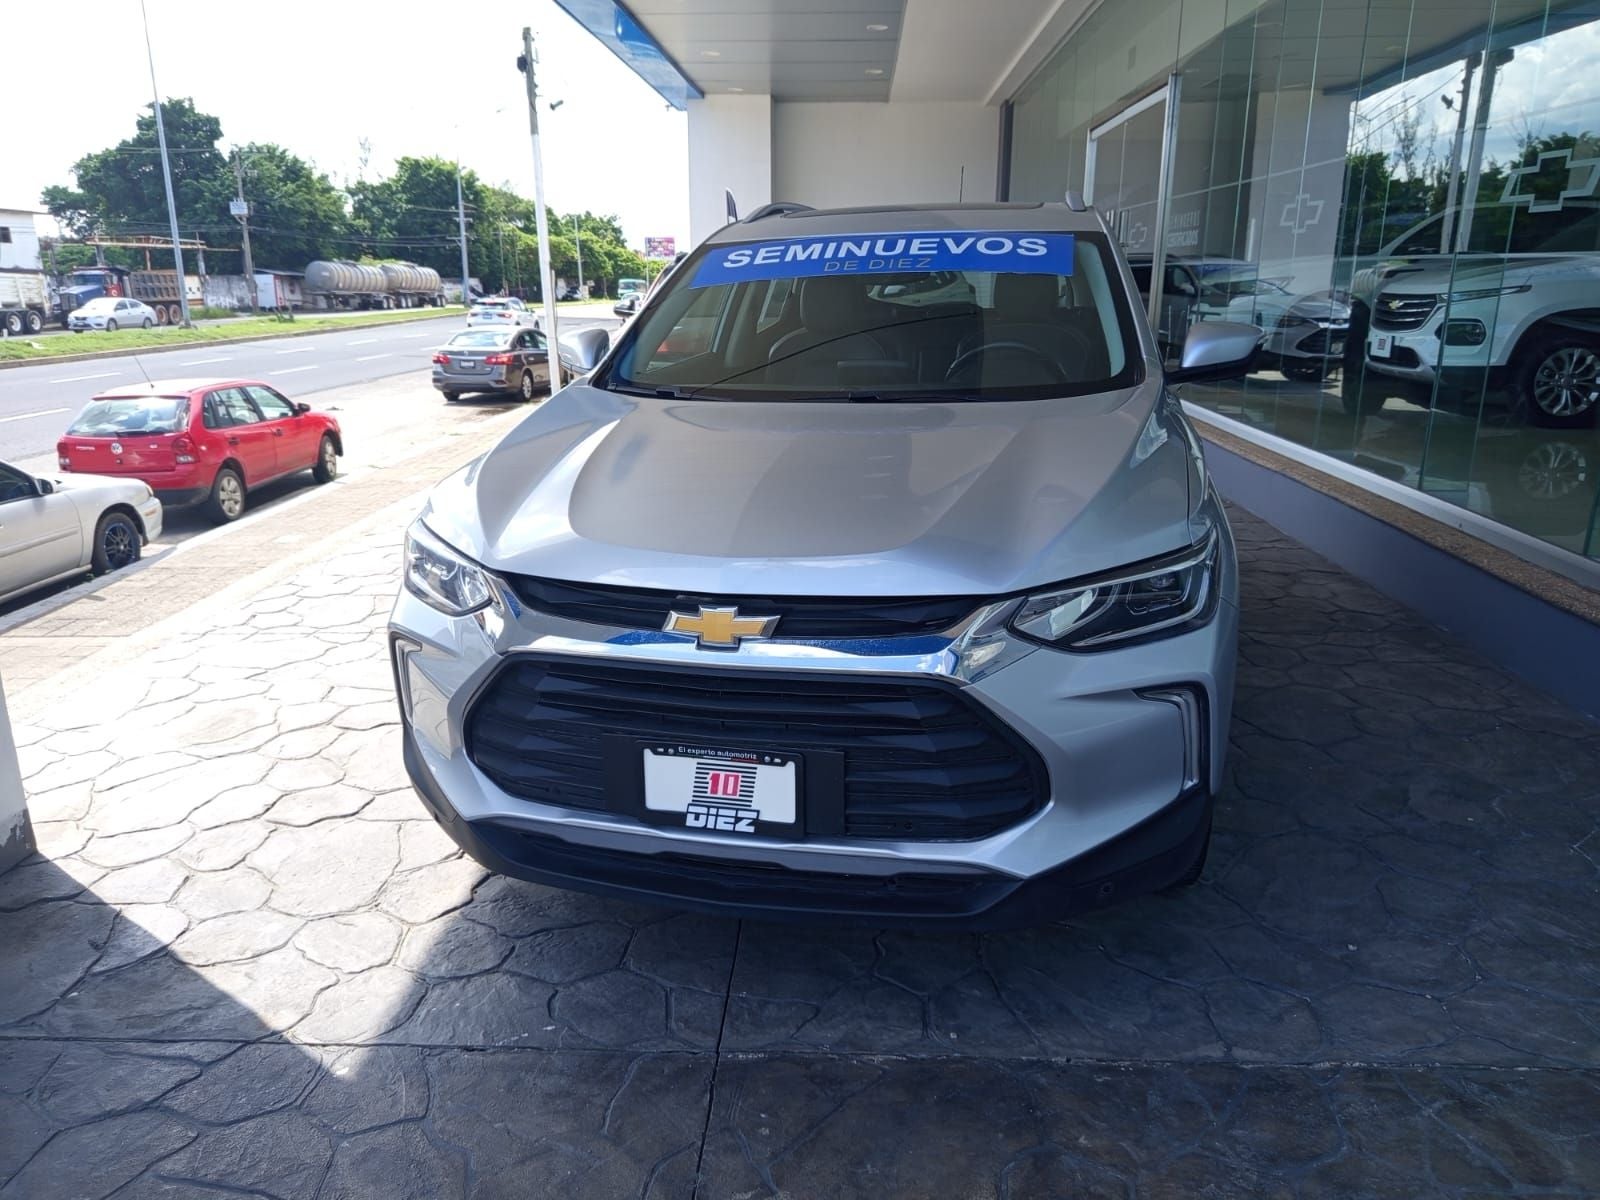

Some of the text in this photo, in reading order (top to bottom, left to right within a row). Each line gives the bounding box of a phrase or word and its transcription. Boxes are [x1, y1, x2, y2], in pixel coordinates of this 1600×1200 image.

[722, 237, 1048, 268] SEMINUEVOS
[824, 258, 931, 272] DE DIEZ
[687, 748, 716, 756] experto
[717, 752, 757, 760] automotriz
[710, 773, 740, 797] 10
[685, 805, 758, 833] DIEZ
